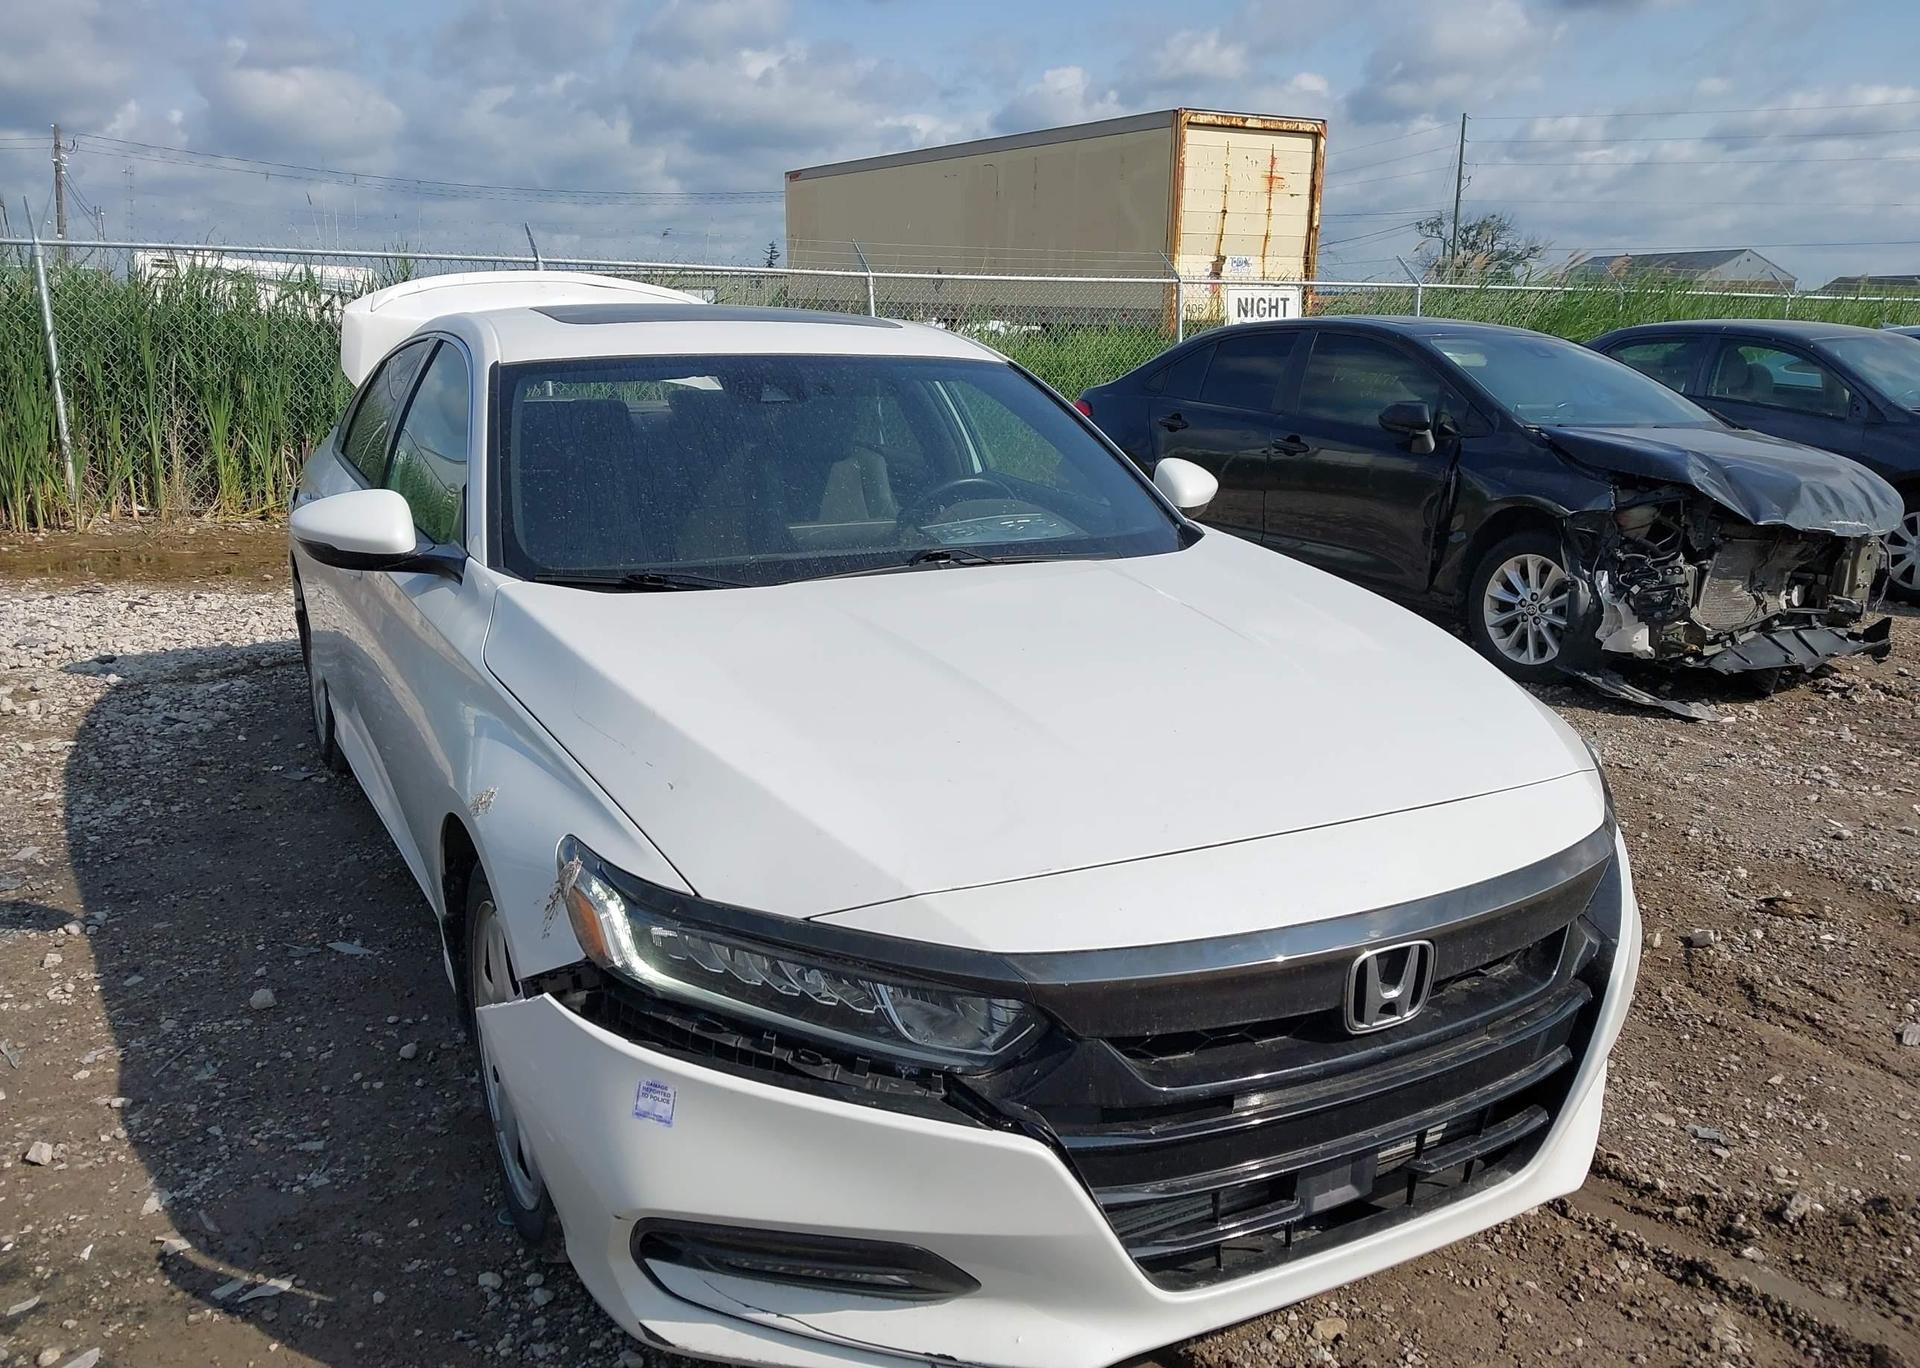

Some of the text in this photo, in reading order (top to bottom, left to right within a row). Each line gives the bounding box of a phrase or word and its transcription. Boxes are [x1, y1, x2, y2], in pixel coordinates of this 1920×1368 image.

[1237, 297, 1290, 318] NIGHT
[645, 1080, 669, 1091] DAMAGE
[642, 1086, 671, 1098] REPORTED
[650, 1094, 670, 1104] POLICE
